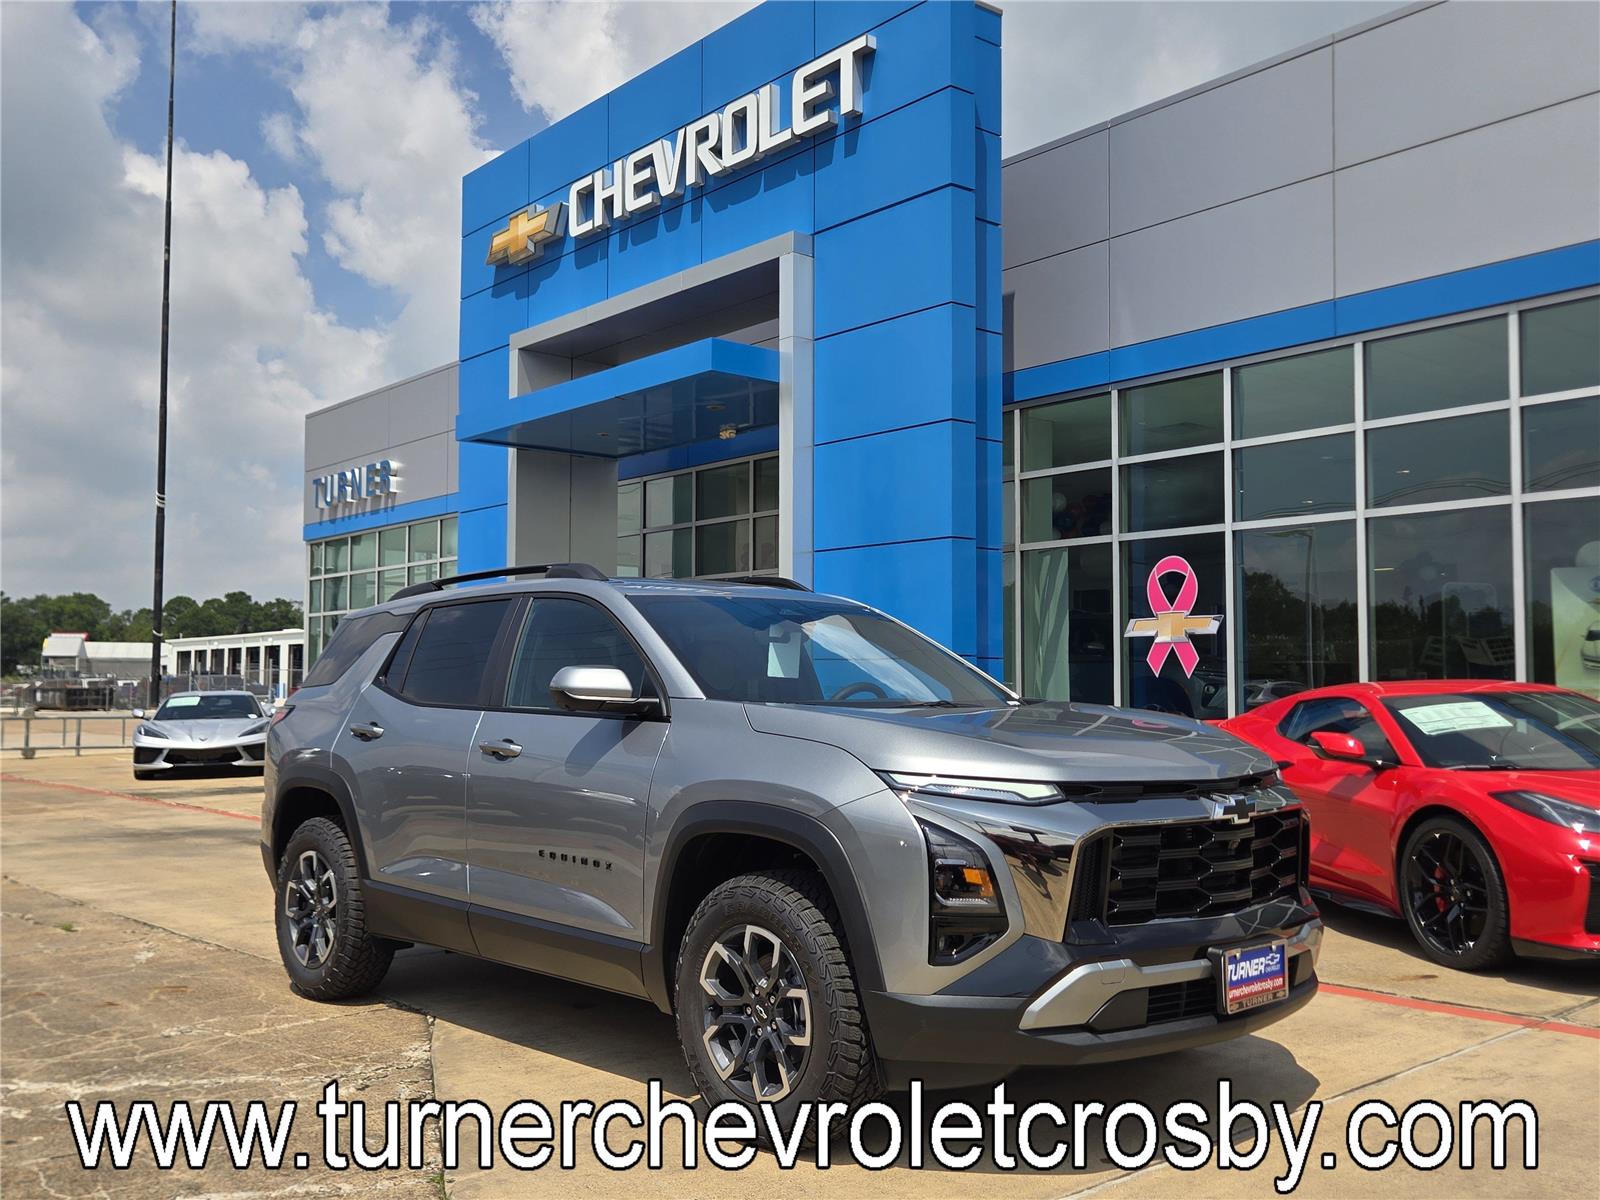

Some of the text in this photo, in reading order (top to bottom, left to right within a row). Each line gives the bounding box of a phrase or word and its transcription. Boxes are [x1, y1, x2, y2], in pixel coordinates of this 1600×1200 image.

[568, 34, 876, 238] CHEVROLET
[312, 459, 398, 509] TURNER
[538, 849, 613, 872] EQUINOX
[1227, 957, 1266, 981] TURNER
[1229, 977, 1283, 998] urnerchevroletcrosby.com
[1242, 993, 1274, 1008] TURNER
